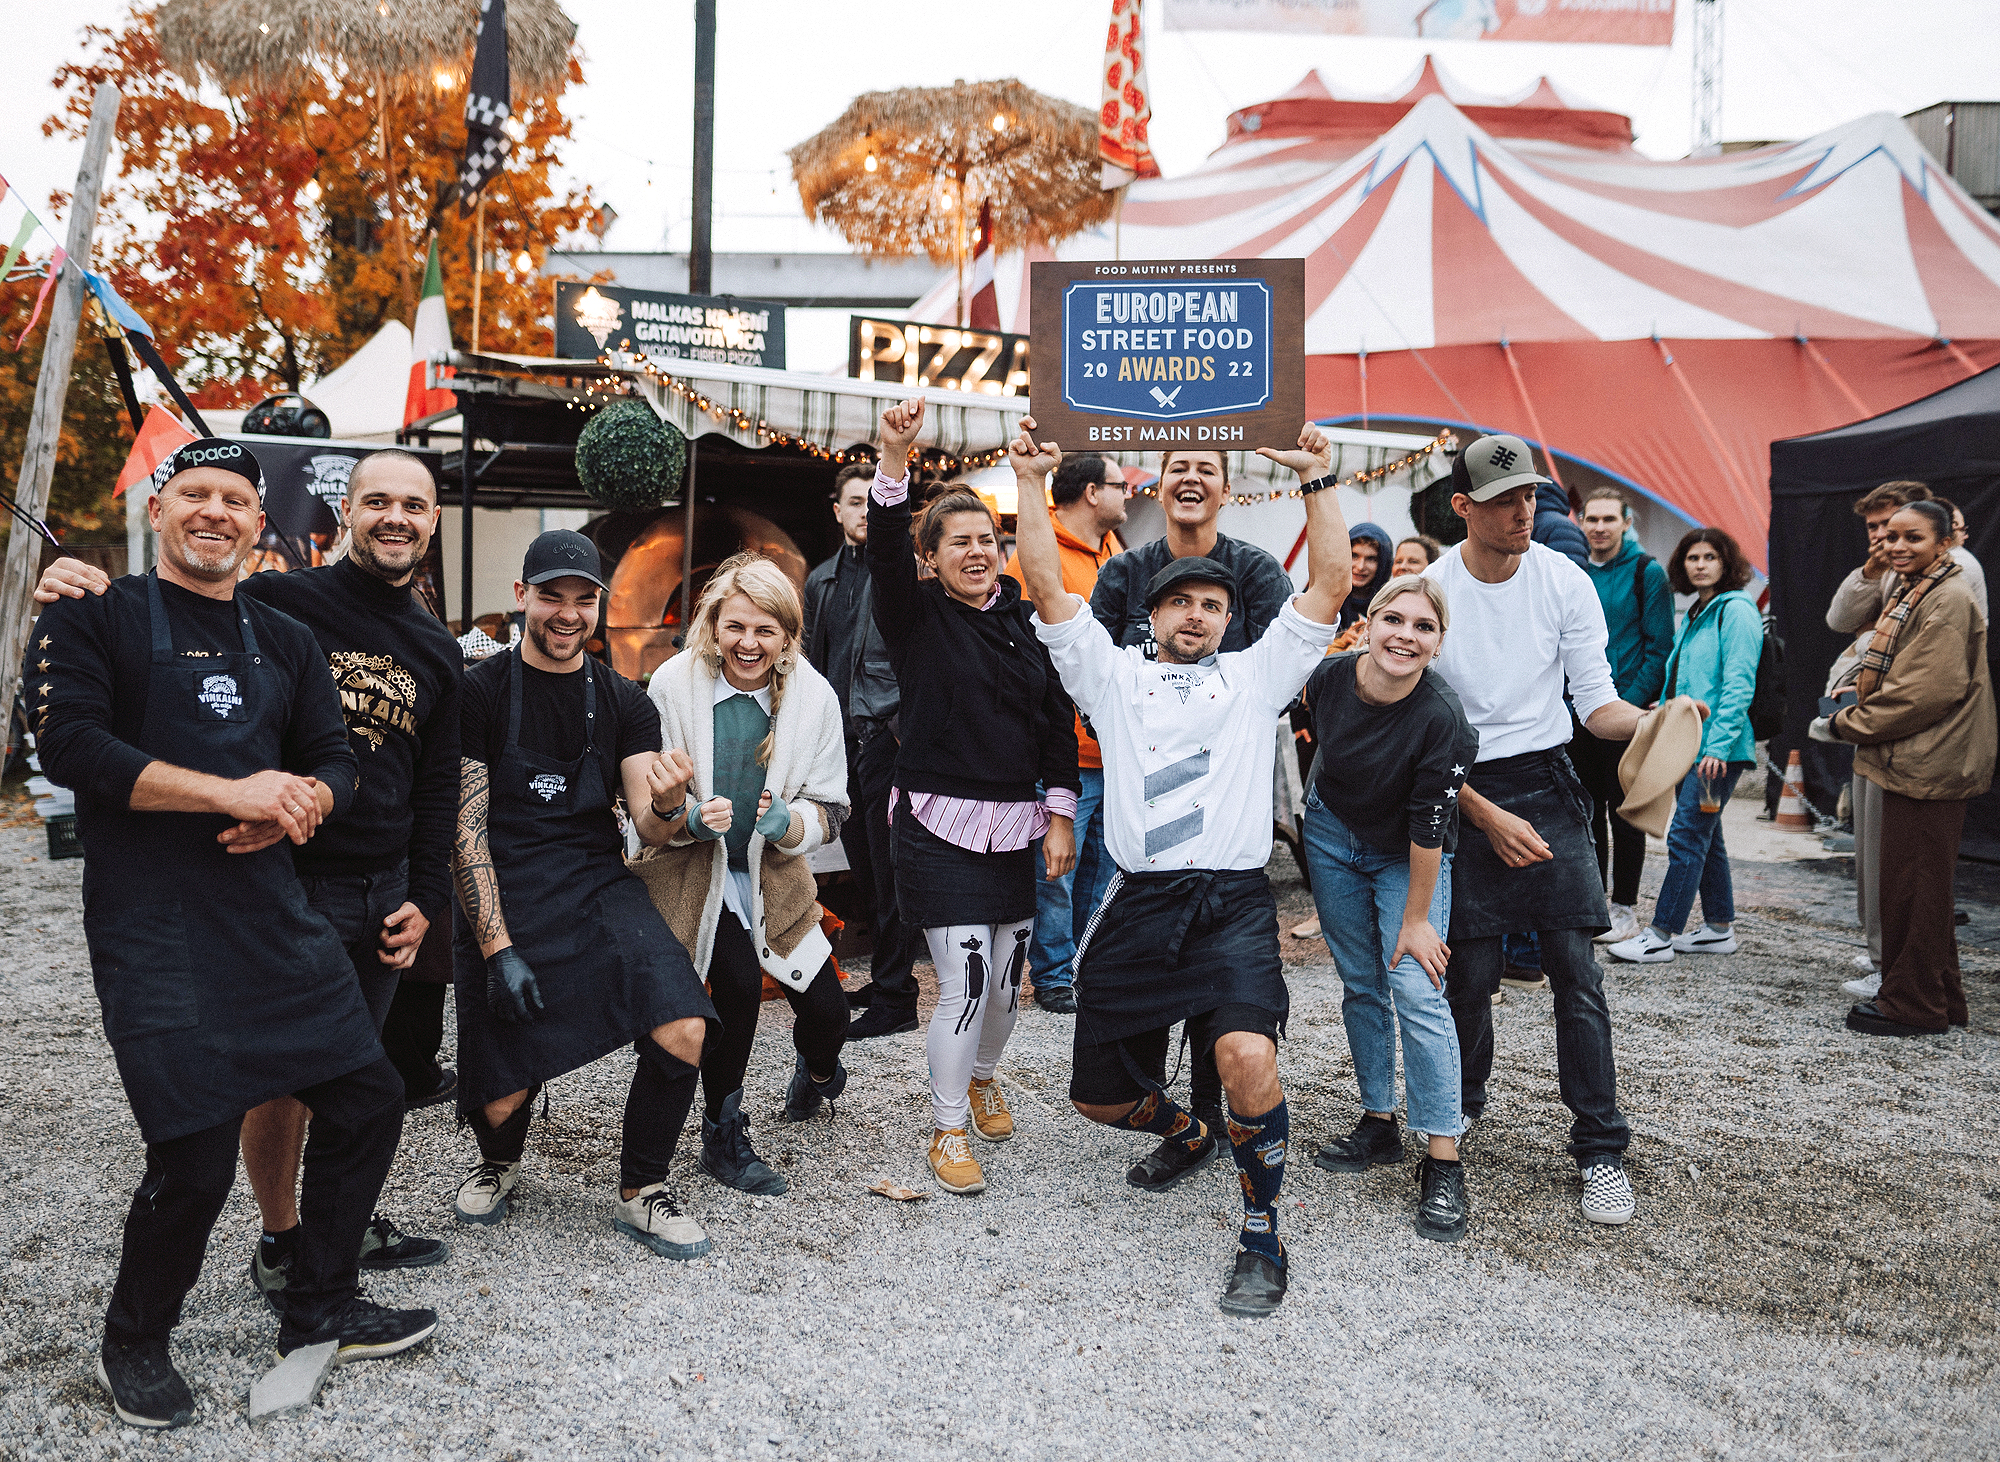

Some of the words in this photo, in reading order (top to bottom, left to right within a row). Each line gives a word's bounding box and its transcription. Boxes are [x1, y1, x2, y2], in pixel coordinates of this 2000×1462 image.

[1095, 266, 1127, 275] FOOD
[1131, 265, 1176, 275] MUTINY
[1180, 264, 1237, 274] PRESENTS
[631, 300, 704, 326] MALKAS
[1096, 291, 1238, 324] EUROPEAN
[634, 321, 725, 348] GATAVOTA
[1081, 329, 1176, 350] STREET
[1183, 328, 1253, 350] FOOD
[638, 342, 680, 358] WOOD
[690, 347, 727, 364] FIRED
[727, 350, 763, 367] PIZZA
[859, 319, 1030, 397] PIZZA
[1083, 362, 1108, 378] 20
[1117, 356, 1216, 381] AWARDS
[1228, 361, 1253, 377] 22
[1089, 426, 1133, 441] BEST
[1139, 426, 1190, 441] MAIN
[1197, 426, 1244, 441] DISH
[191, 444, 242, 466] paco
[552, 542, 588, 557] Callaway
